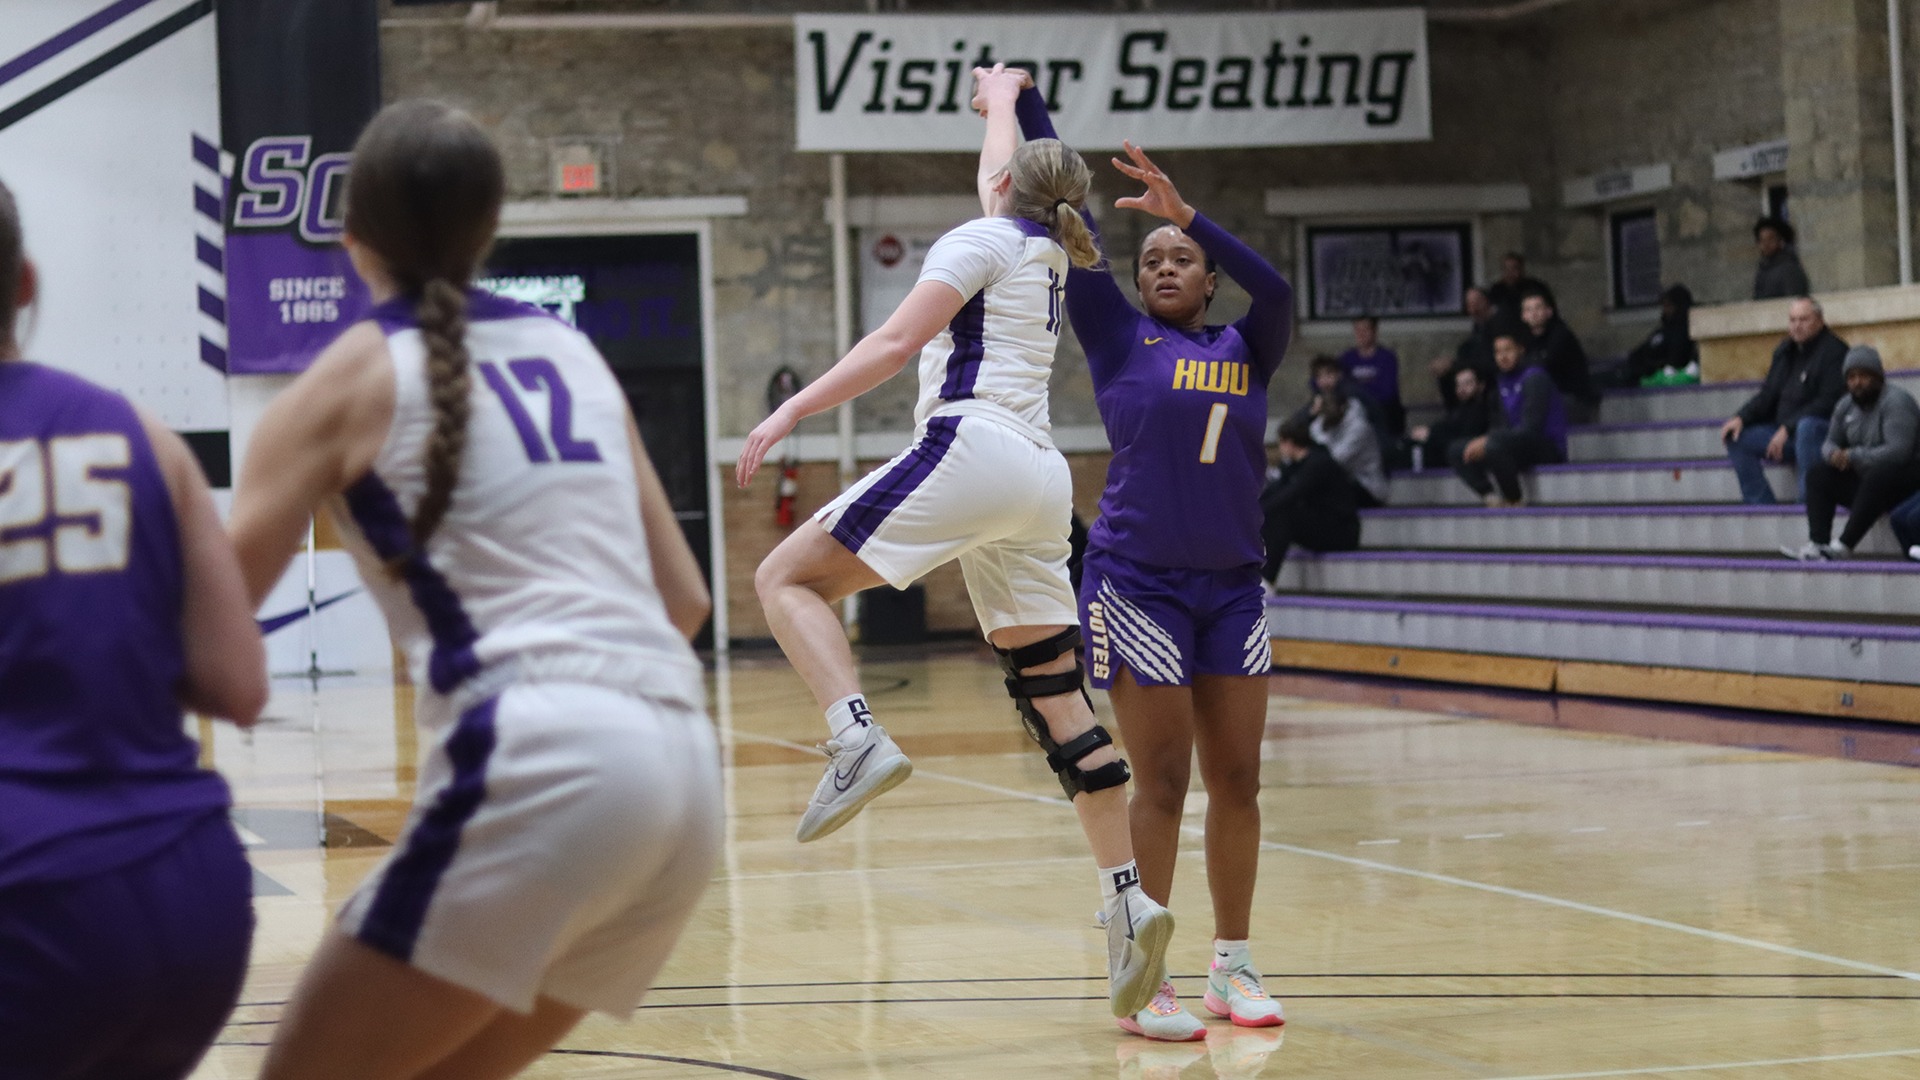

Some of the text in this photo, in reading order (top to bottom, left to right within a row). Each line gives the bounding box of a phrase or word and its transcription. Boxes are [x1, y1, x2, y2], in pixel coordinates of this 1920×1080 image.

[1110, 31, 1415, 127] Seating
[269, 275, 346, 301] SINCE
[477, 356, 603, 464] 12
[1172, 358, 1249, 397] KWU
[1199, 402, 1228, 464] 1
[1087, 601, 1110, 680] YOTES
